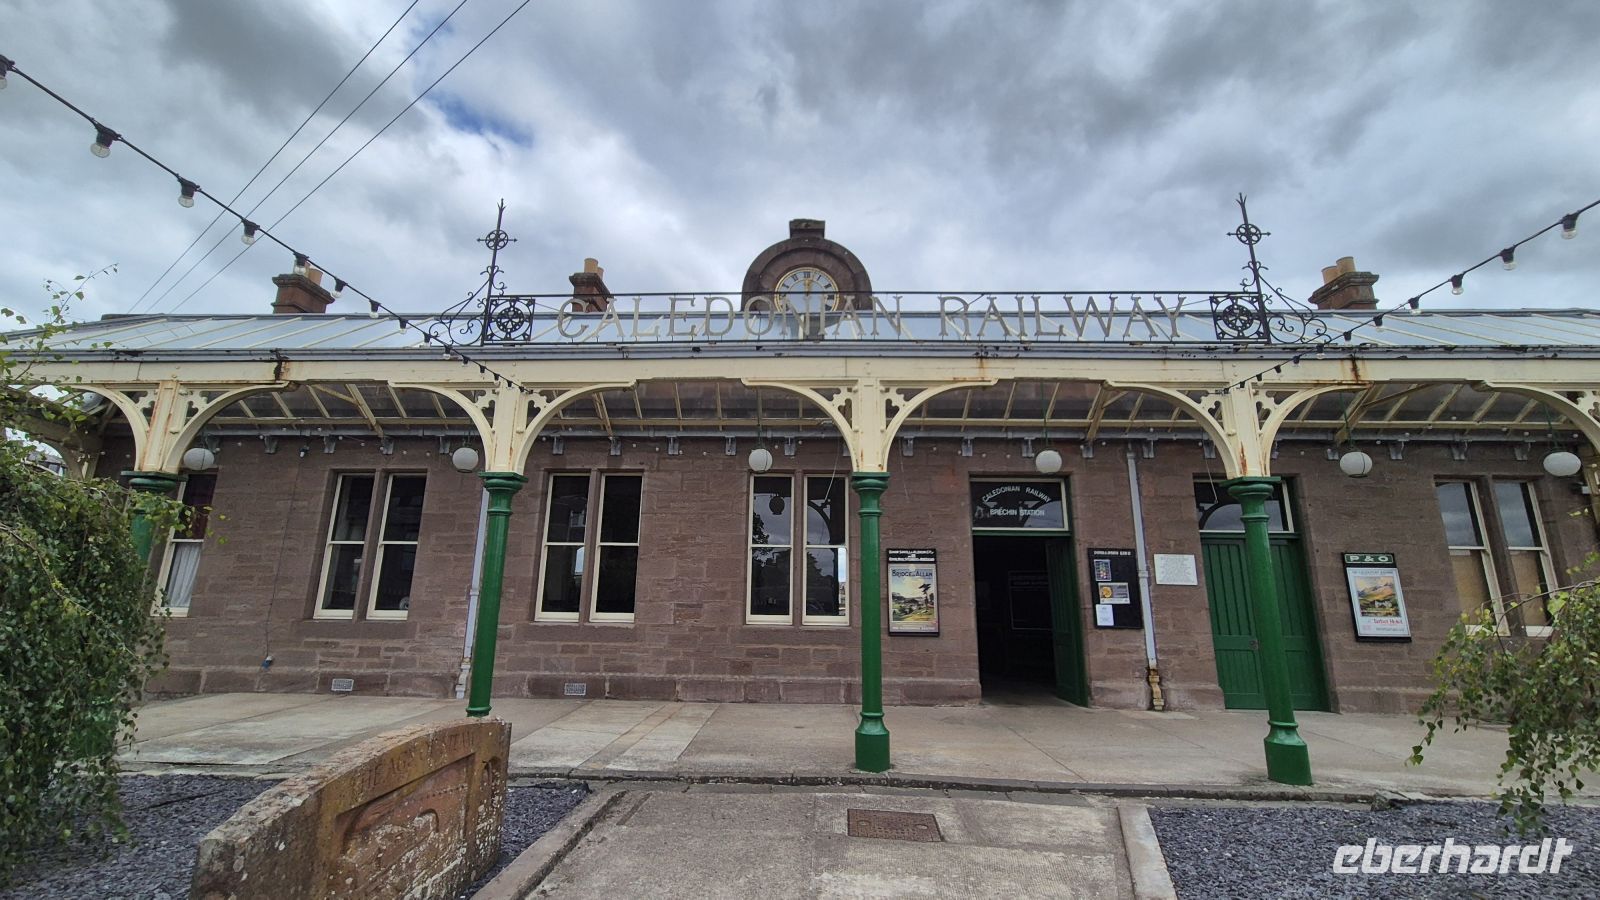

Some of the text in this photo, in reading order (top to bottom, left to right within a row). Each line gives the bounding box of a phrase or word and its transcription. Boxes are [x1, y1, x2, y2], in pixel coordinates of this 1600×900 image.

[557, 295, 1186, 338] CALEDONIAN RAILWAY
[982, 485, 1052, 503] CALEDONIAN RAILWAY
[989, 507, 1045, 517] BRECHIN STATION
